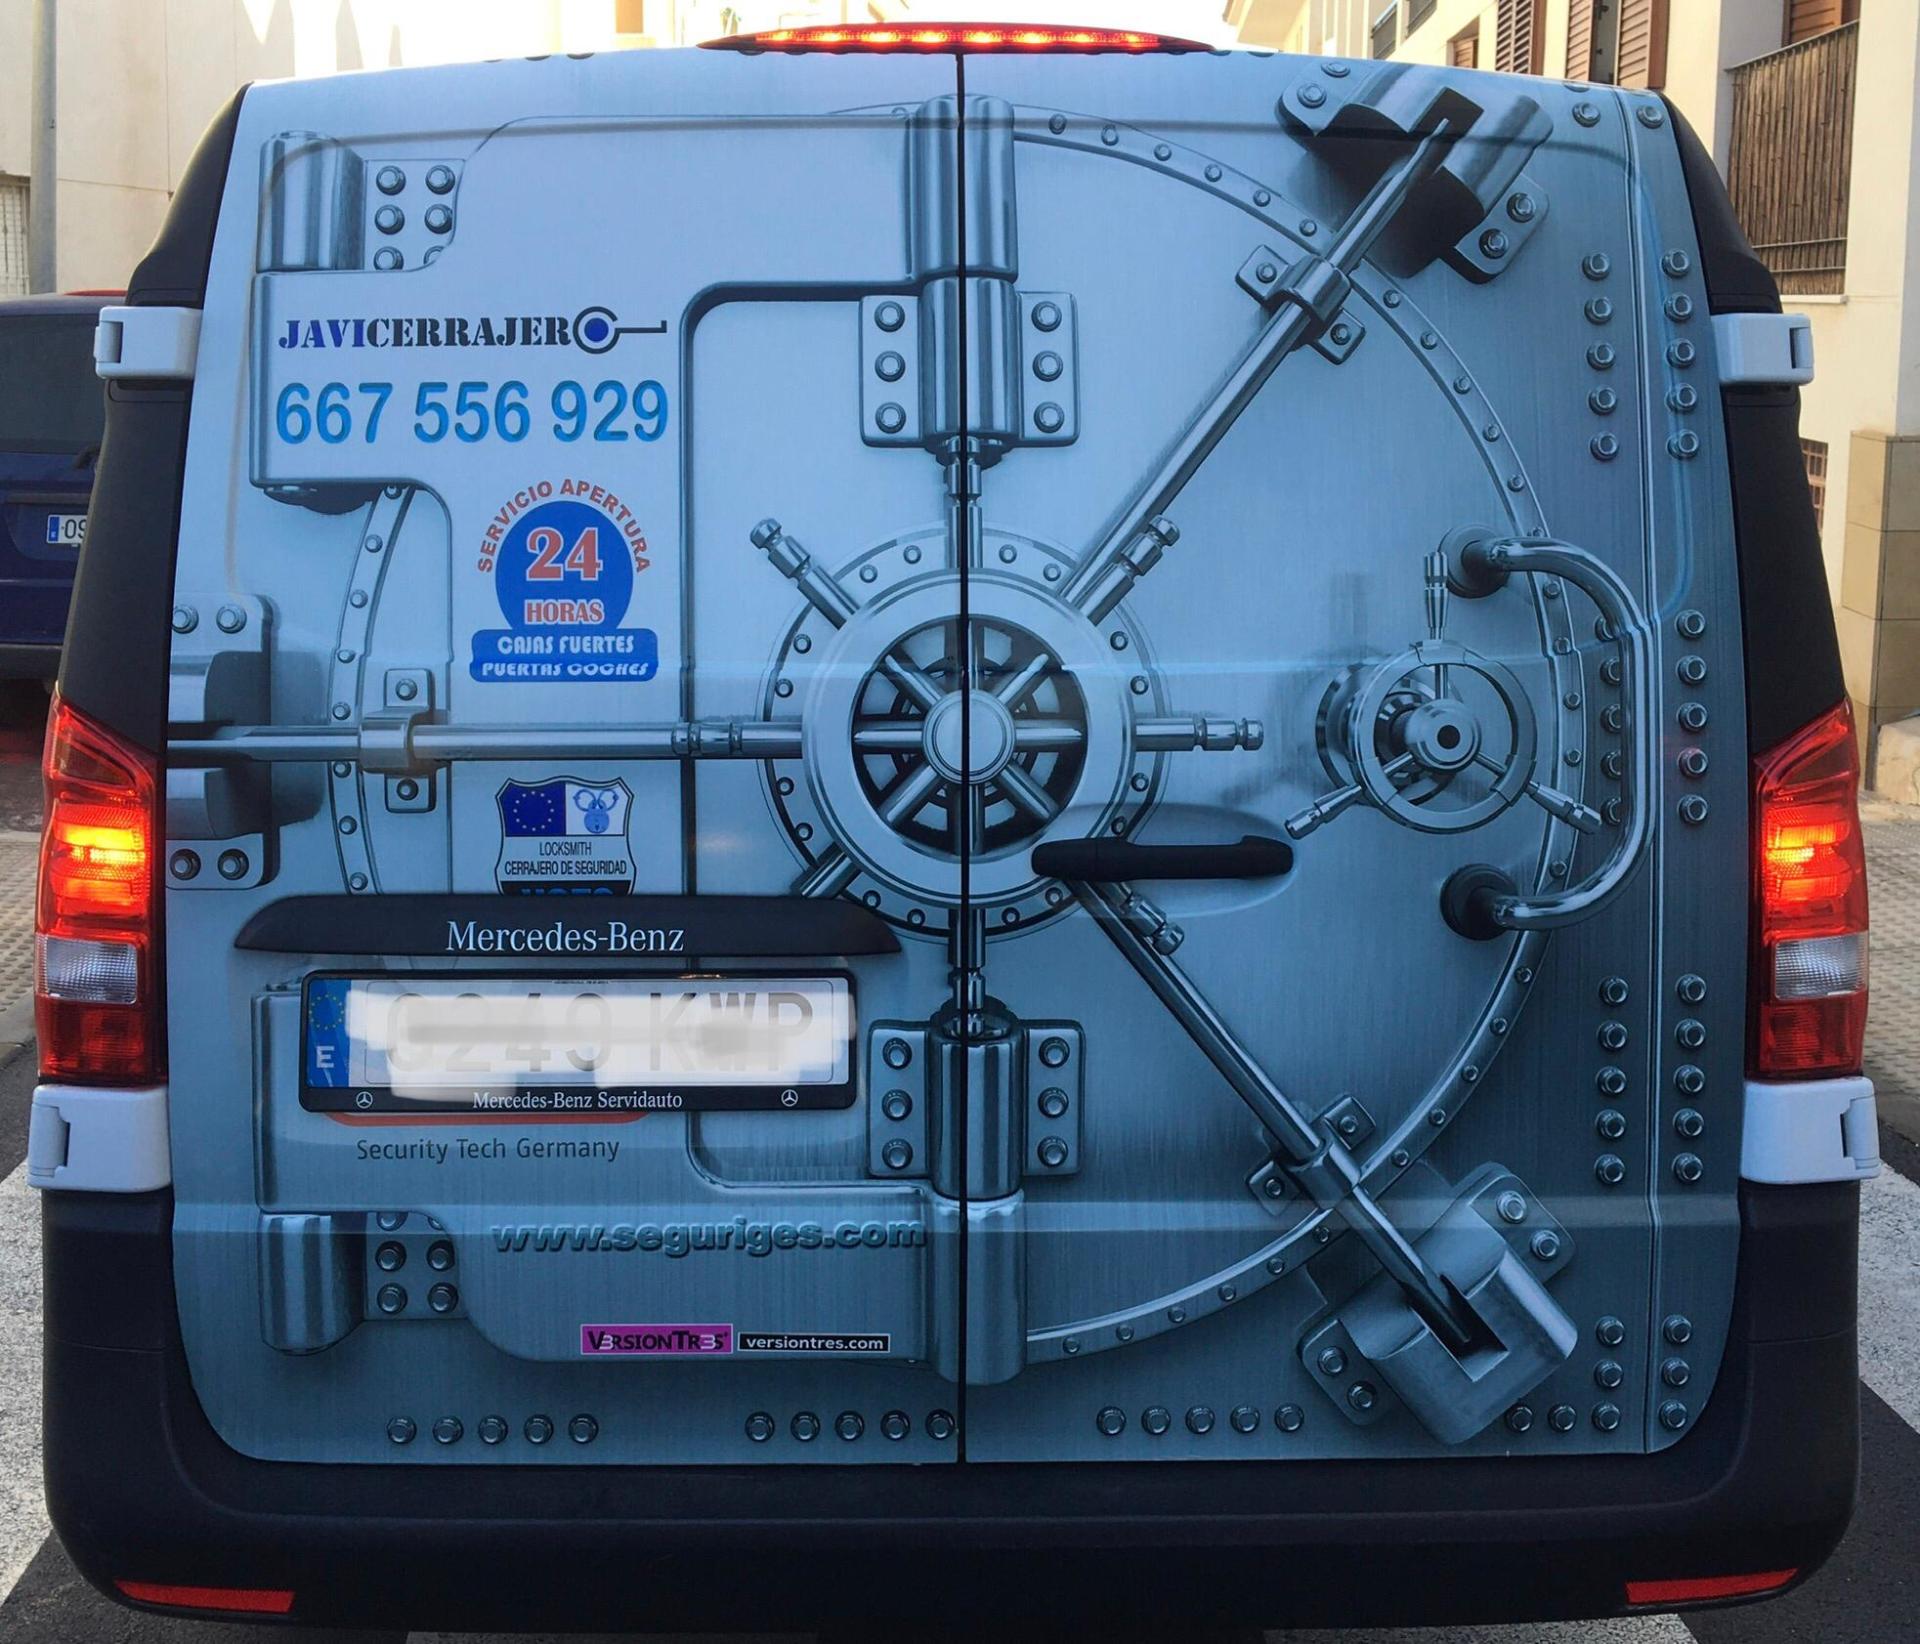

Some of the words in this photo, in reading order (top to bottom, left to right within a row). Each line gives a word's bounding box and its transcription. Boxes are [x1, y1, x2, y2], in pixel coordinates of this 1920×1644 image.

[276, 382, 393, 444] 667
[414, 381, 531, 443] 556
[551, 380, 668, 442] 929
[477, 481, 553, 573] SERVICIO
[560, 478, 650, 574] APERTURA
[526, 526, 603, 581] 24
[524, 598, 605, 625] HORAS
[497, 635, 554, 655] CAJAS
[558, 634, 634, 654] FUERTES
[482, 662, 562, 676] PUERTAS
[566, 662, 649, 676] COCHES
[539, 841, 592, 856] LOCKSMITH
[505, 860, 559, 875] CERRAJERO
[560, 860, 574, 874] DE
[575, 859, 627, 875] SEGURIDAD
[446, 920, 685, 953] Mercedes-Benz
[316, 1045, 335, 1068] E
[472, 1091, 593, 1109] Mercedes-Benz
[597, 1091, 683, 1109] Servidauto
[356, 1139, 449, 1165] Security
[456, 1138, 506, 1159] Tech
[516, 1137, 620, 1162] Germany
[493, 1216, 928, 1258] www.seguriges.com
[746, 1336, 884, 1350] versiontres.com
